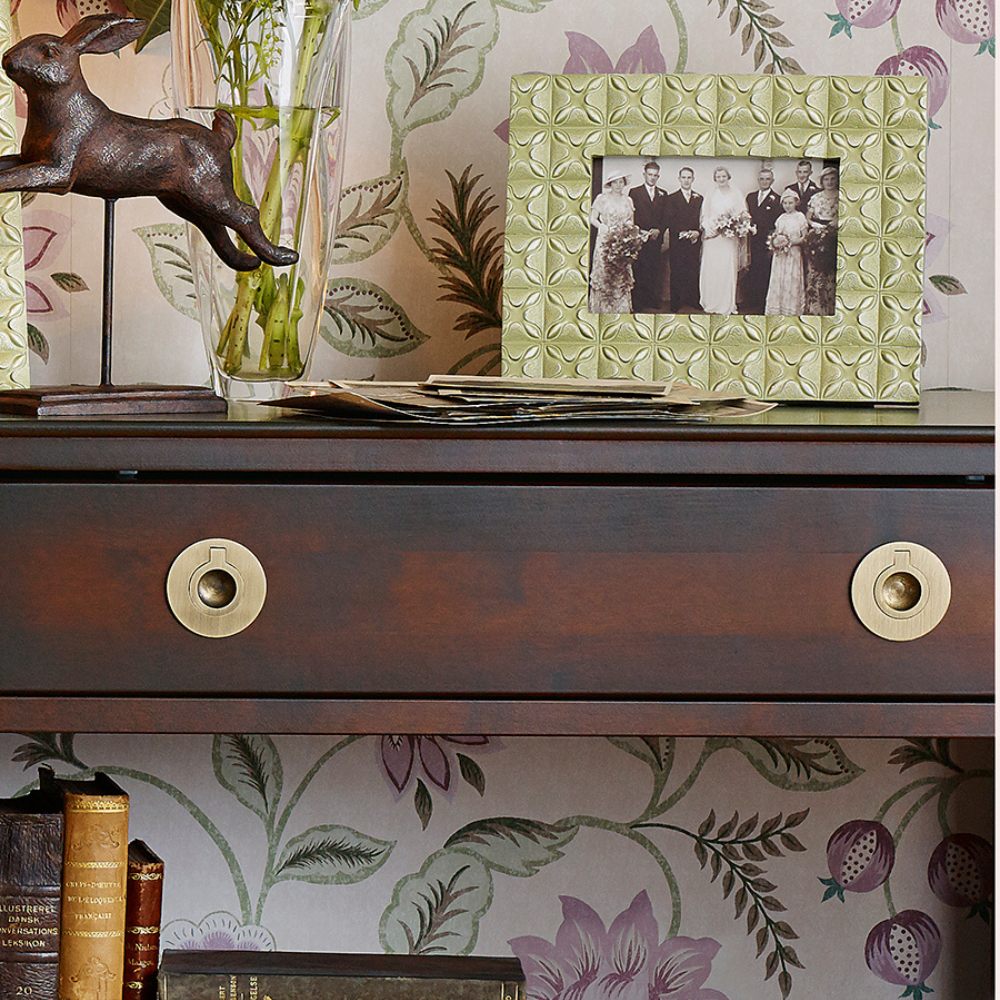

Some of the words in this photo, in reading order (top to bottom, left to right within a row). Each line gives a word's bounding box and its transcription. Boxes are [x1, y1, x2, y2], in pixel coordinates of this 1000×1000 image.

[8, 915, 41, 924] DANSK
[1, 939, 47, 948] LEKSIKON
[15, 986, 33, 996] 20
